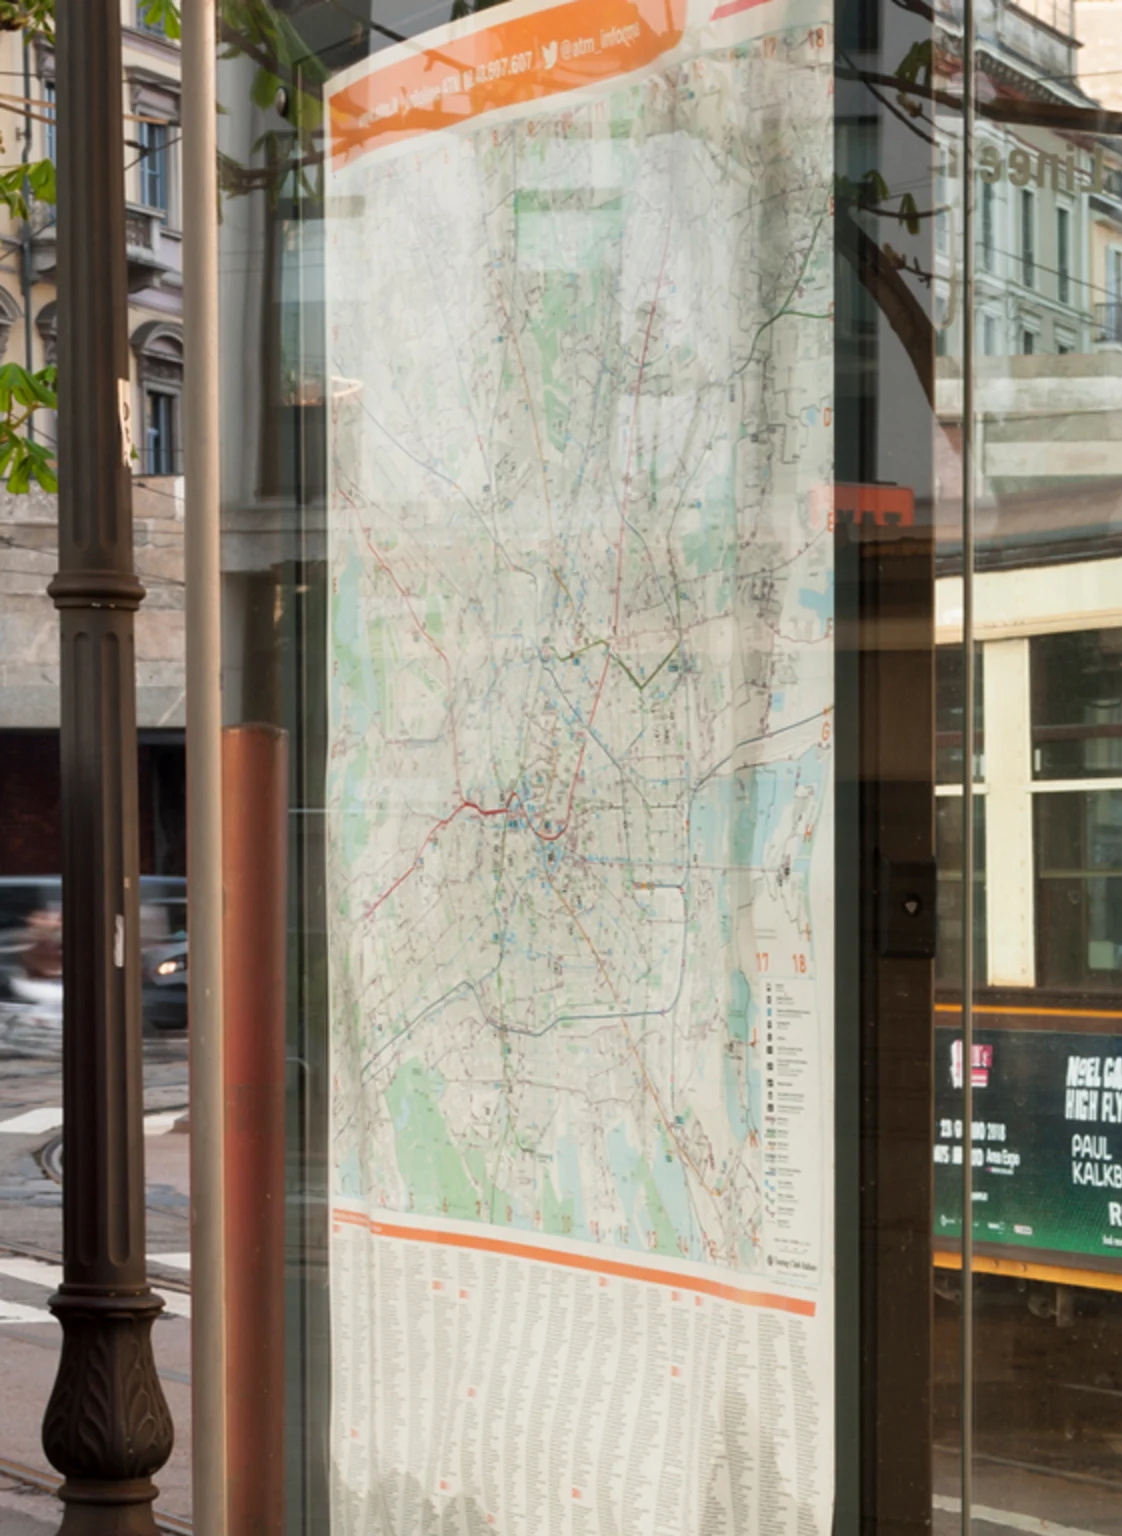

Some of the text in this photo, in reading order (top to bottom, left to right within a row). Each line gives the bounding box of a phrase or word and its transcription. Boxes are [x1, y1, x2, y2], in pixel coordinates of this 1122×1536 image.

[756, 951, 807, 975] 17 18
[1065, 1088, 1099, 1121] HIGH
[1071, 1133, 1113, 1160] PAUL
